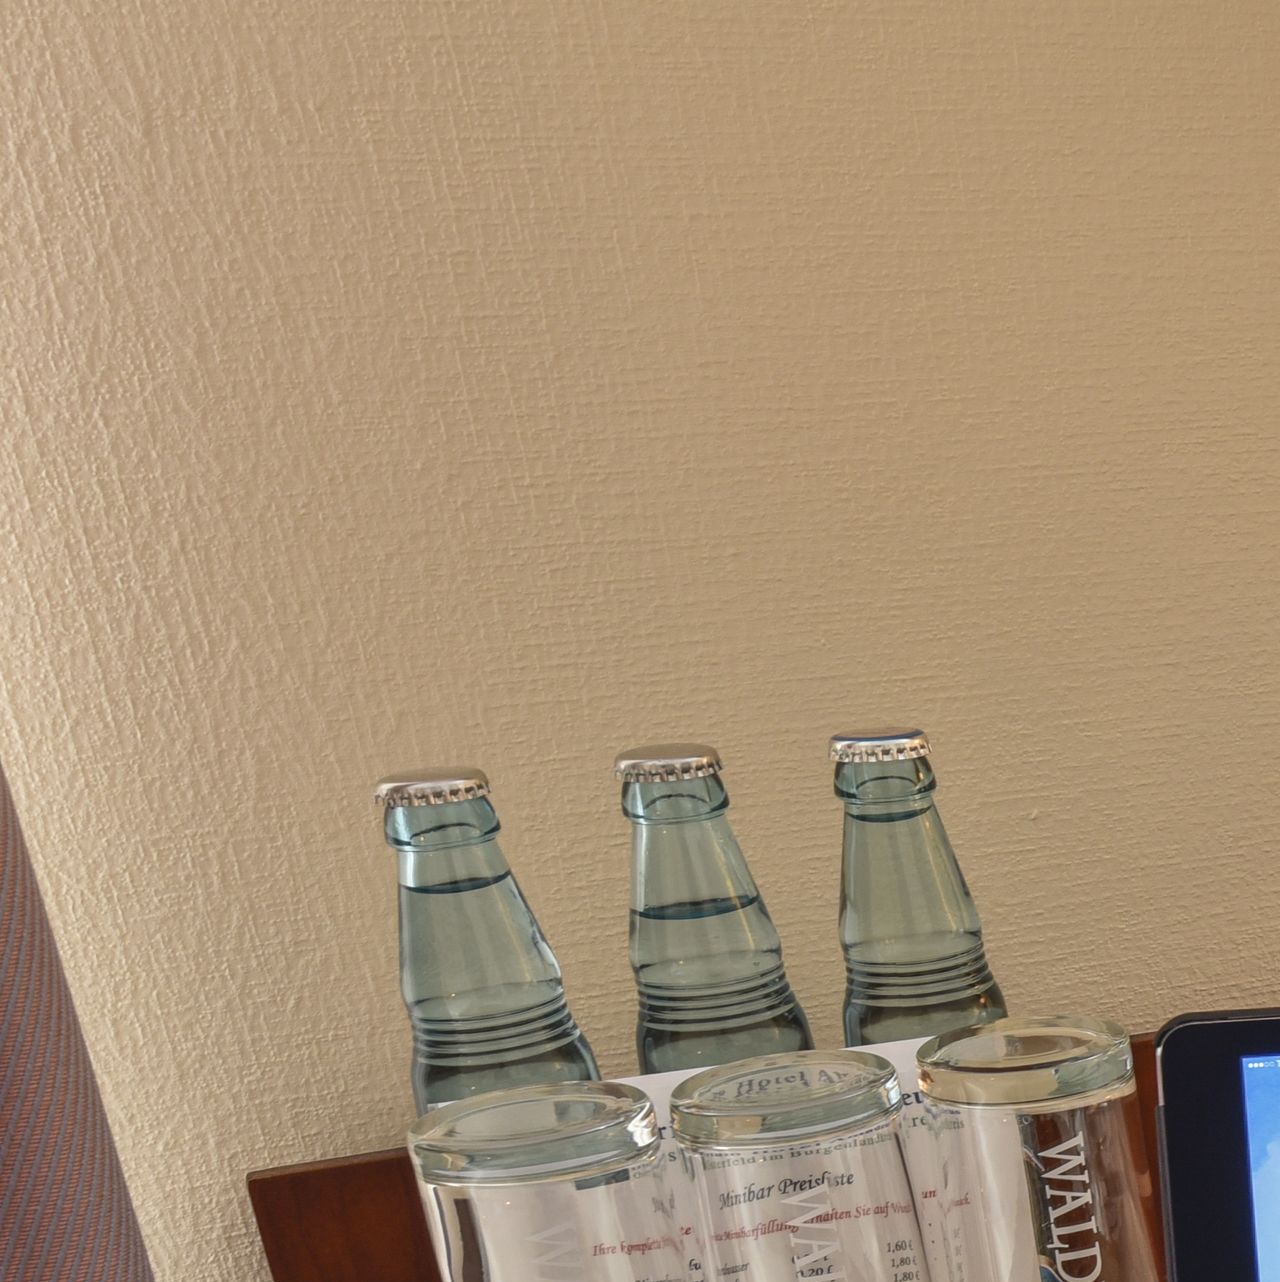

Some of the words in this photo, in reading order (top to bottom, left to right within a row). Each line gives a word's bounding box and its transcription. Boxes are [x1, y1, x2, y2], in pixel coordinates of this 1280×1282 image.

[719, 1183, 776, 1210] Minibar
[592, 1242, 617, 1257] Ihre
[854, 1205, 871, 1218] Sie
[873, 1203, 890, 1219] auf
[890, 1256, 912, 1268] 1,80
